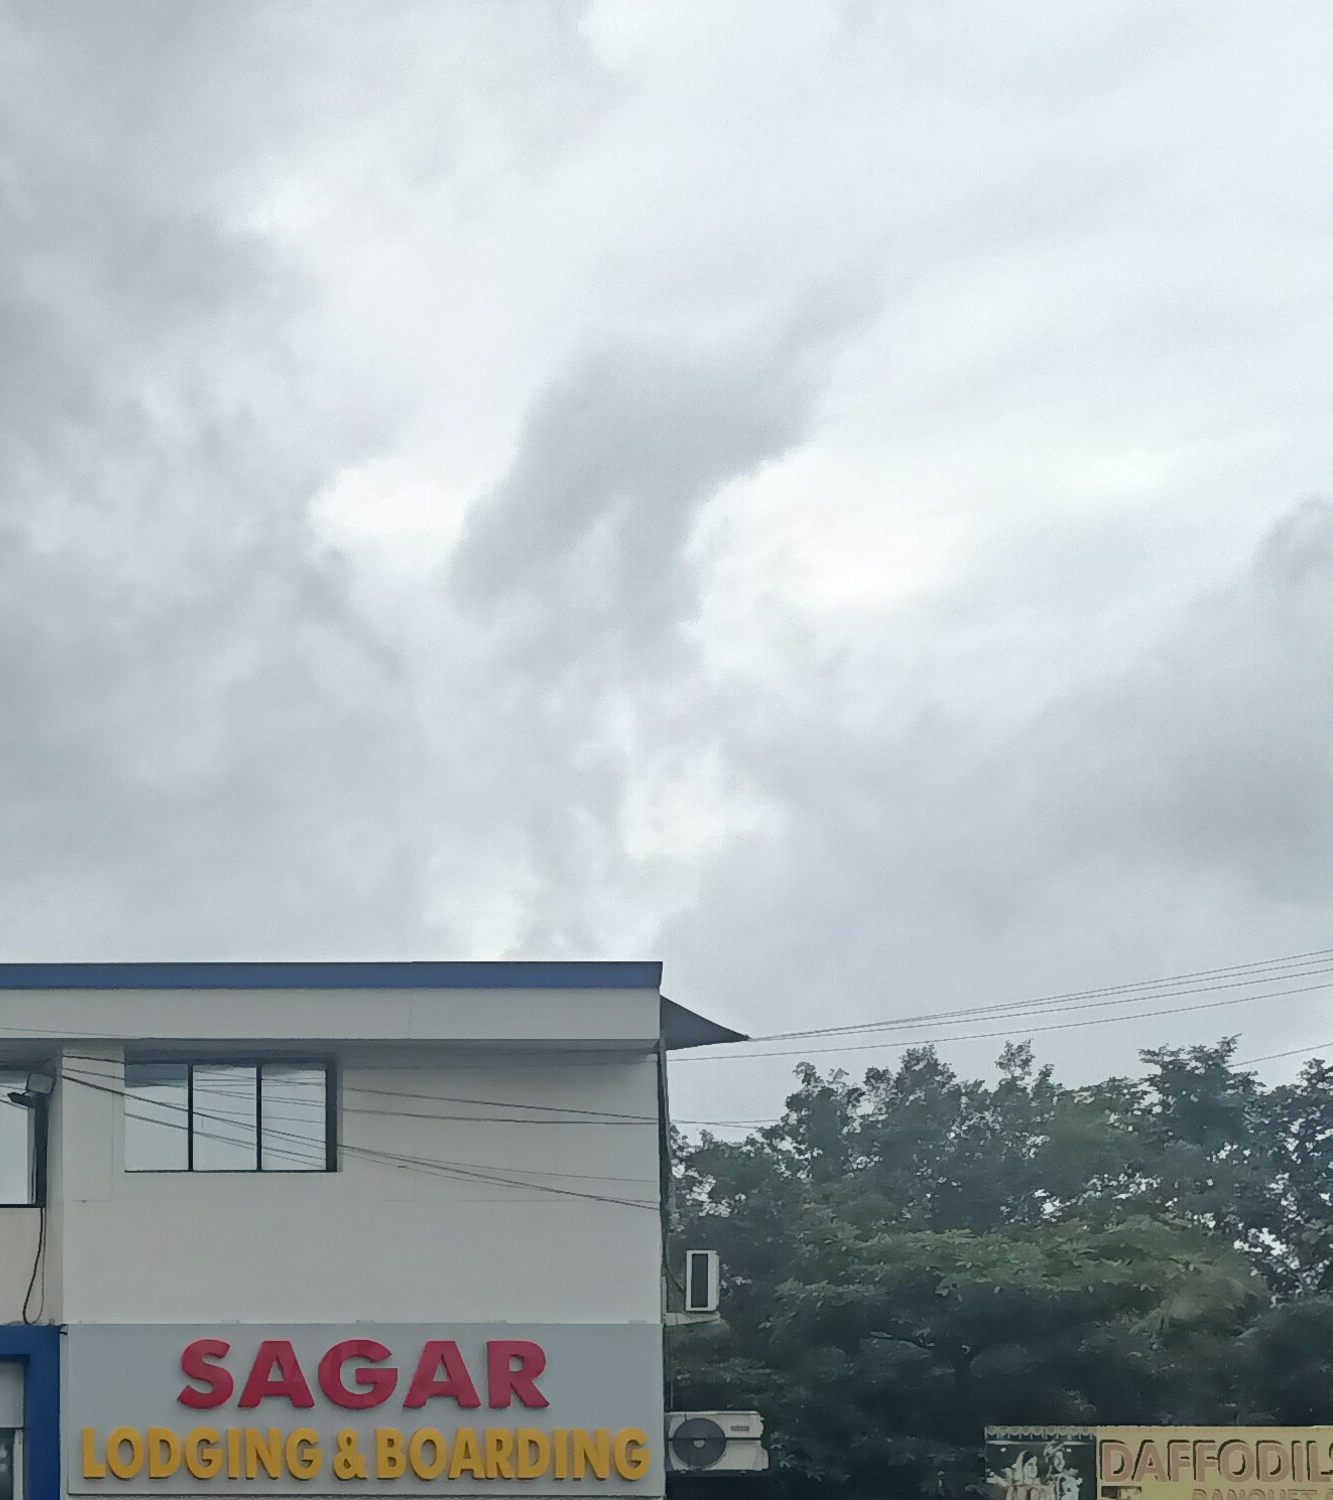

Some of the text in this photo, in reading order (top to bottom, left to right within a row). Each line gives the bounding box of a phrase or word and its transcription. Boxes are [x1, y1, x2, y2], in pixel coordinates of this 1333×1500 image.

[177, 1339, 550, 1410] SAGAR
[82, 1426, 652, 1481] LODGING & BOARDING
[1100, 1439, 1333, 1483] DAFFODIL
